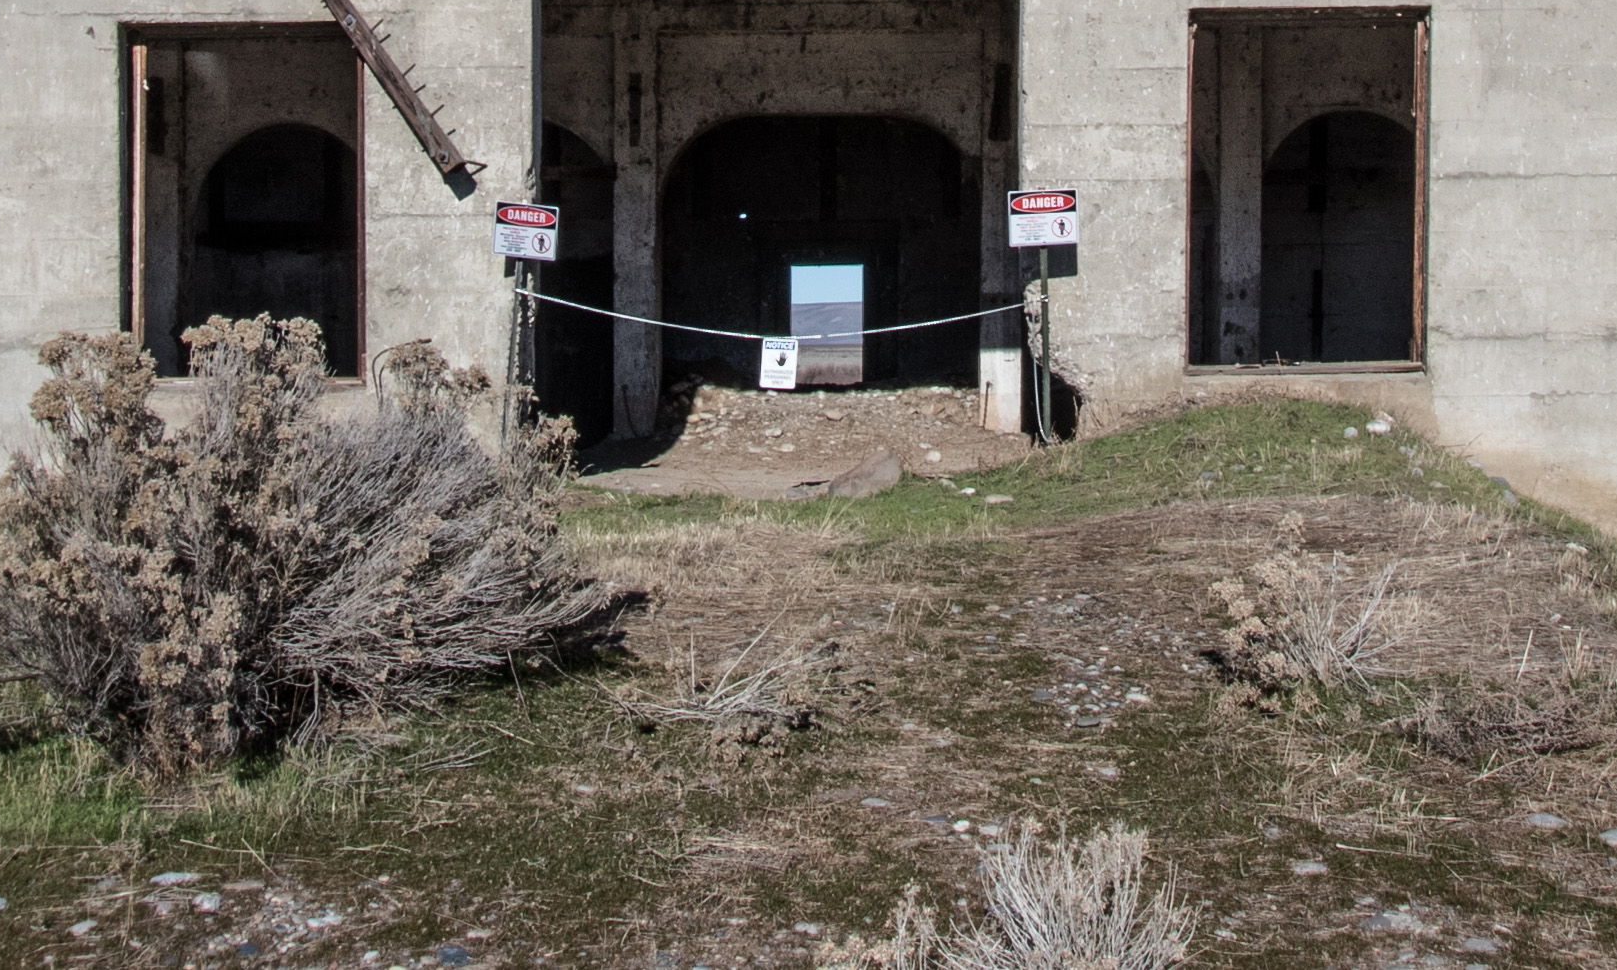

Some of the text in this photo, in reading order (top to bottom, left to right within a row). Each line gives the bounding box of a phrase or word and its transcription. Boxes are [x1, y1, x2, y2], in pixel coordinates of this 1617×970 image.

[1022, 196, 1064, 209] DANGER
[507, 209, 546, 223] DANGER
[765, 341, 795, 350] NOTICE
